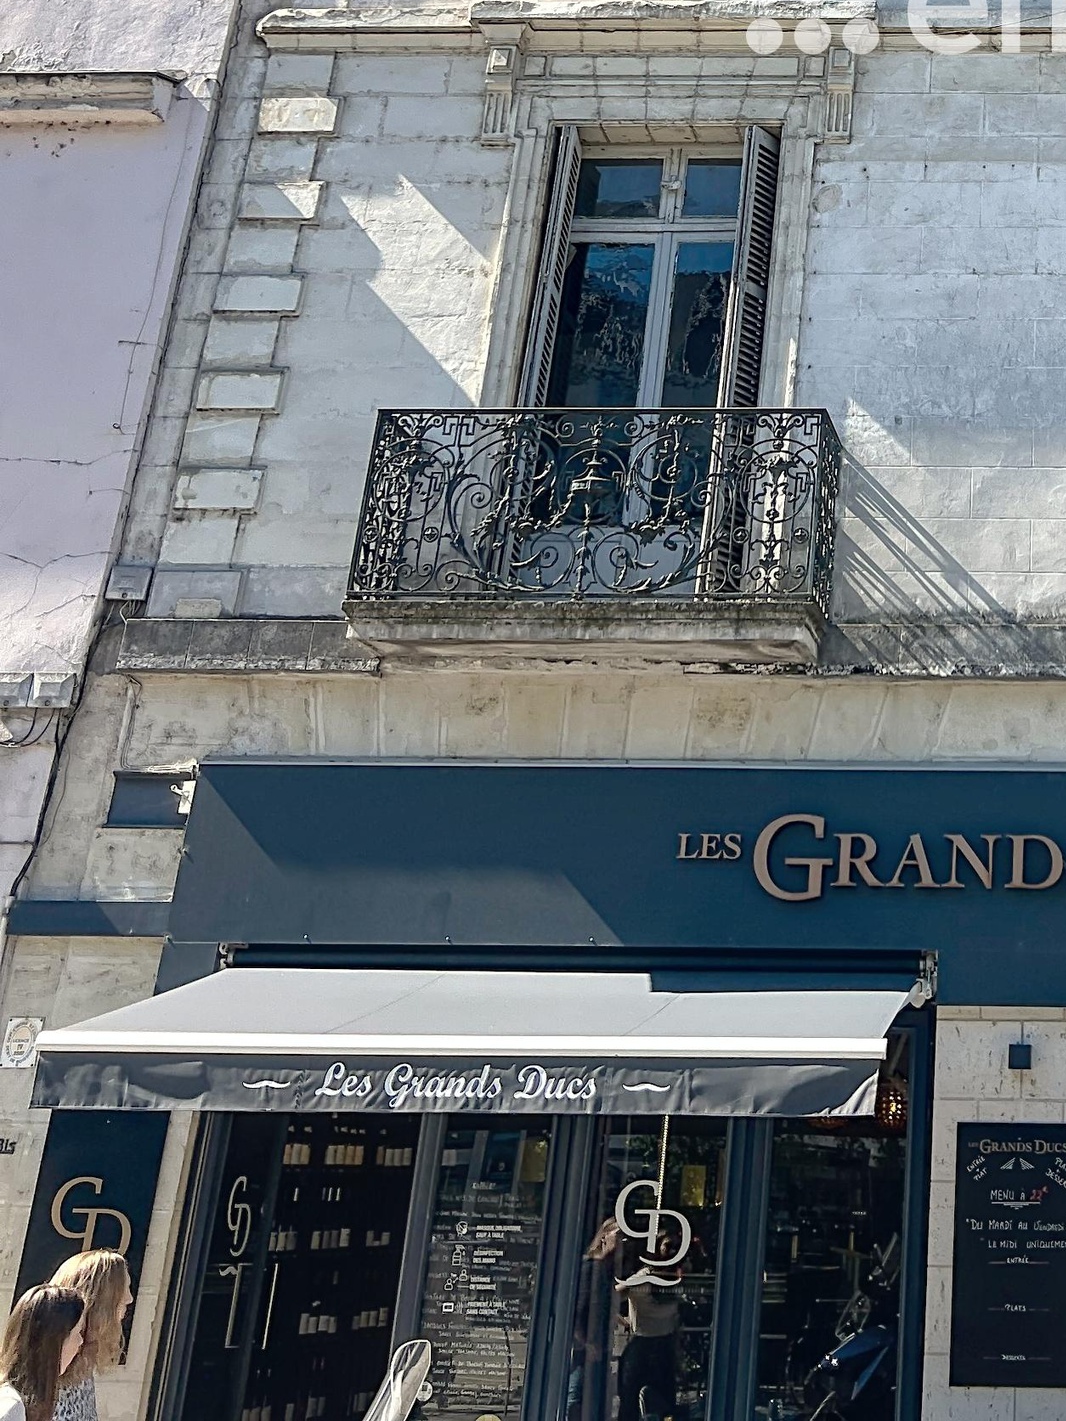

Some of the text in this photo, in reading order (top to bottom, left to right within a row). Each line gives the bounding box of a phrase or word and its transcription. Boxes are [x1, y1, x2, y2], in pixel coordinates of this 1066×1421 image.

[676, 832, 742, 861] LES
[314, 1062, 598, 1108] Les Grands Ducs
[979, 1139, 1033, 1154] GRANDS
[990, 1189, 1014, 1201] MENU
[614, 1180, 691, 1266] GD
